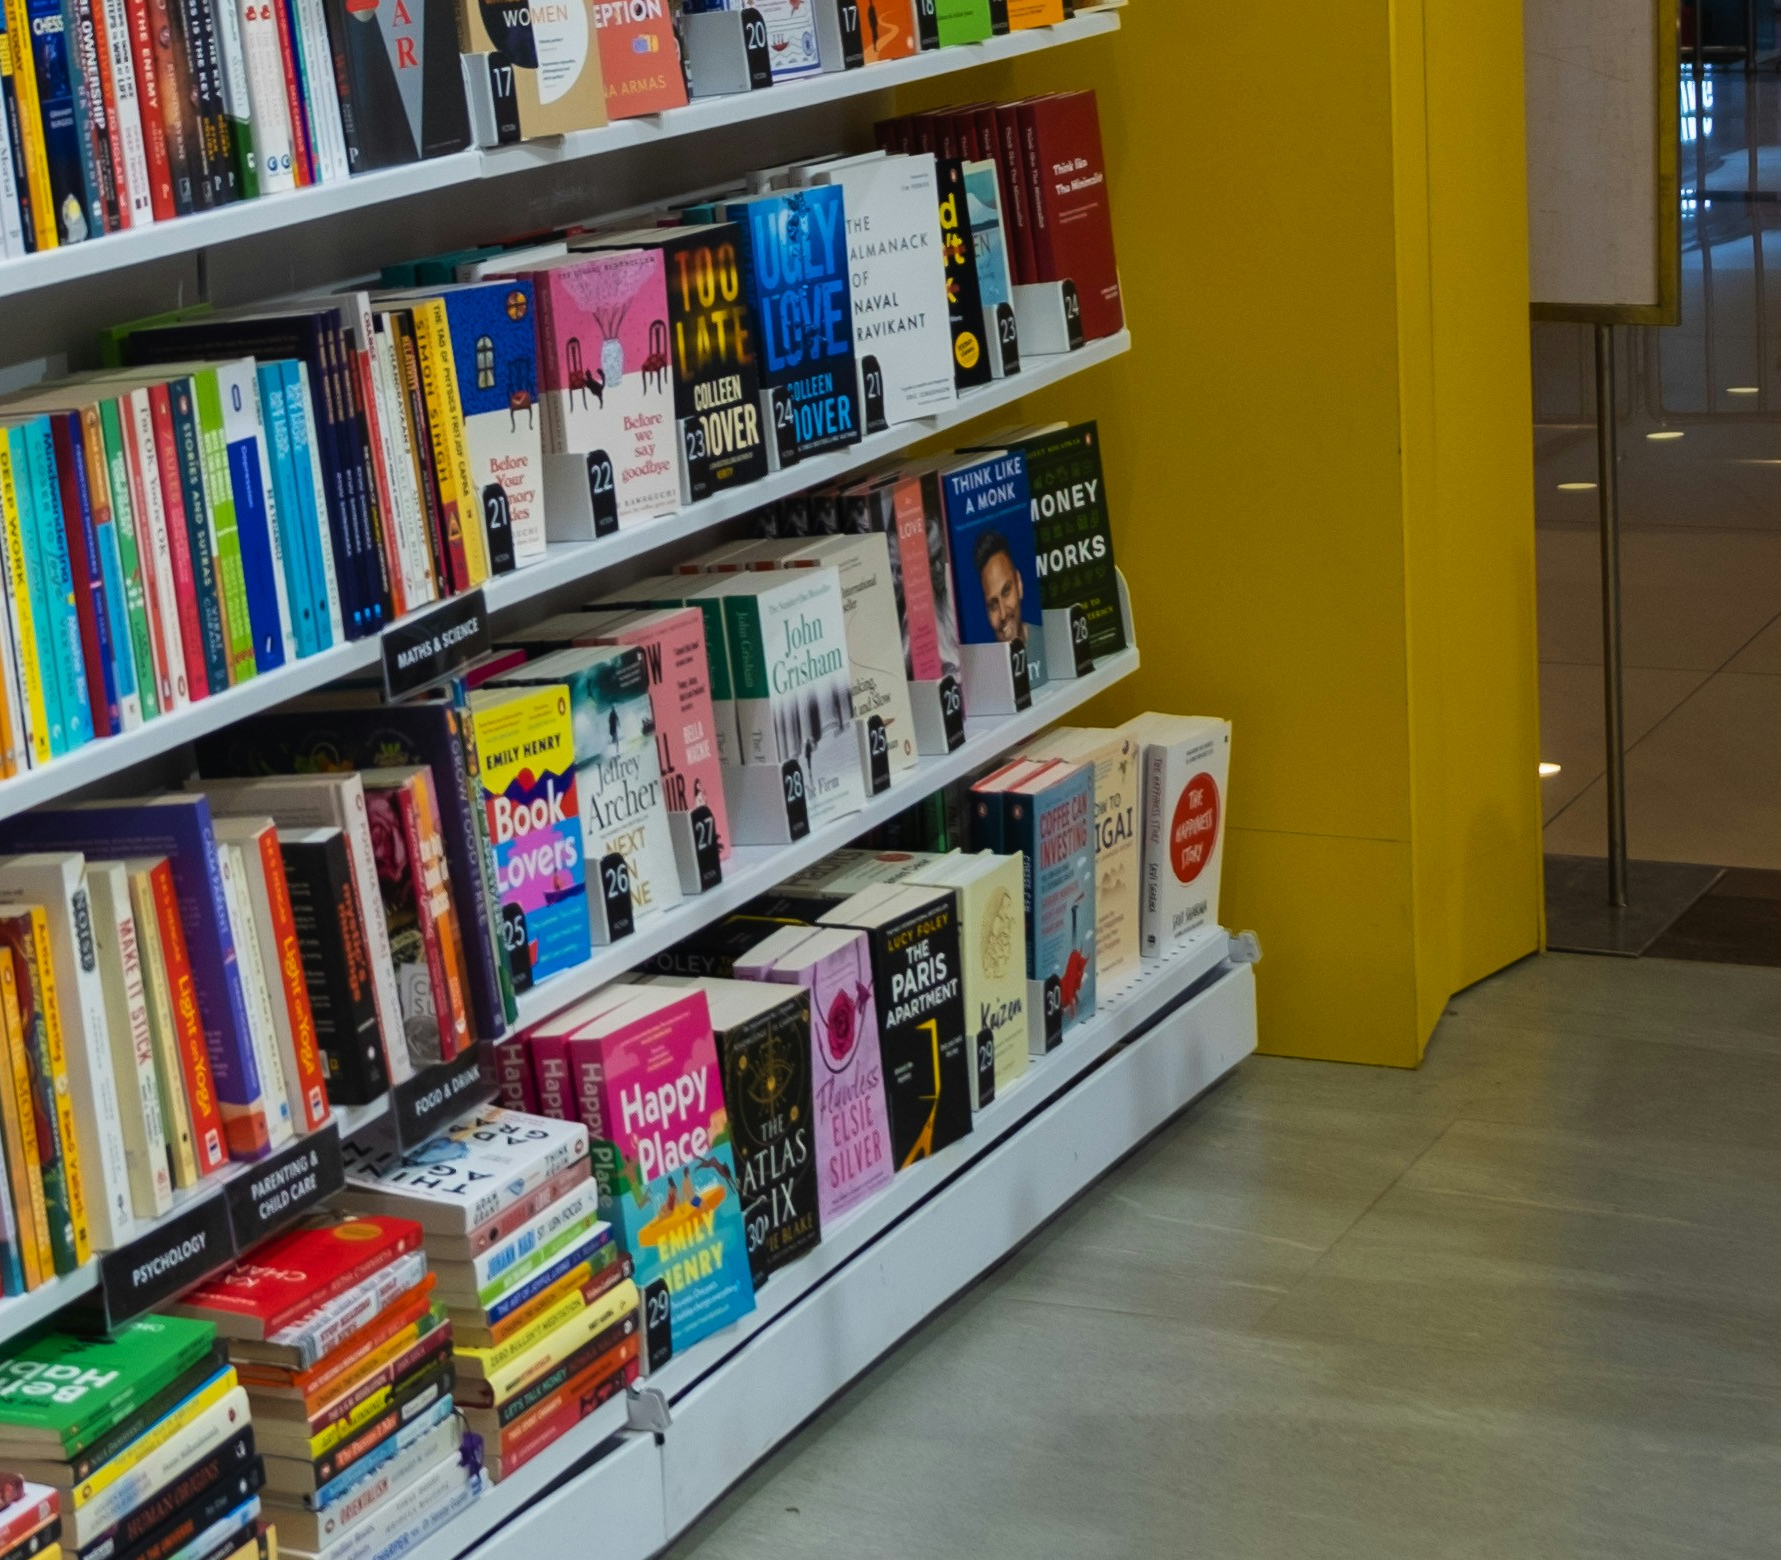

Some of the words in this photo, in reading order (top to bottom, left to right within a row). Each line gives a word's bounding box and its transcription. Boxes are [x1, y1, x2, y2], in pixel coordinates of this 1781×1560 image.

[493, 67, 512, 97] 17
[754, 196, 842, 291] UGLY
[849, 233, 929, 261] ALMANACK
[763, 278, 848, 373] LOVE
[854, 294, 898, 315] NAVAL
[856, 313, 926, 342] RAVIKANT
[591, 463, 612, 493] 22
[951, 465, 991, 495] THINK
[994, 457, 1023, 478] LIKE
[966, 498, 976, 514] A
[980, 482, 1016, 509] MONK
[397, 637, 432, 668] MATHS
[434, 634, 442, 653] &
[445, 616, 480, 650] SCIENCE
[487, 746, 519, 771] EMILY
[523, 734, 561, 758] HENRY
[495, 780, 565, 844] Book
[496, 836, 577, 893] Lovers
[891, 953, 948, 1000] PARIS
[886, 977, 958, 1028] APARTMENT
[415, 1095, 440, 1117] FOOD
[441, 1086, 452, 1104] &
[455, 1066, 479, 1095] DRINK
[620, 1066, 709, 1137] Happy
[250, 1158, 304, 1200] PARENTING
[307, 1151, 318, 1168] &
[638, 1128, 710, 1182] Place
[257, 1189, 290, 1222] CHILD
[293, 1174, 317, 1202] CARE
[132, 1232, 207, 1288] PSYCHOLOGY
